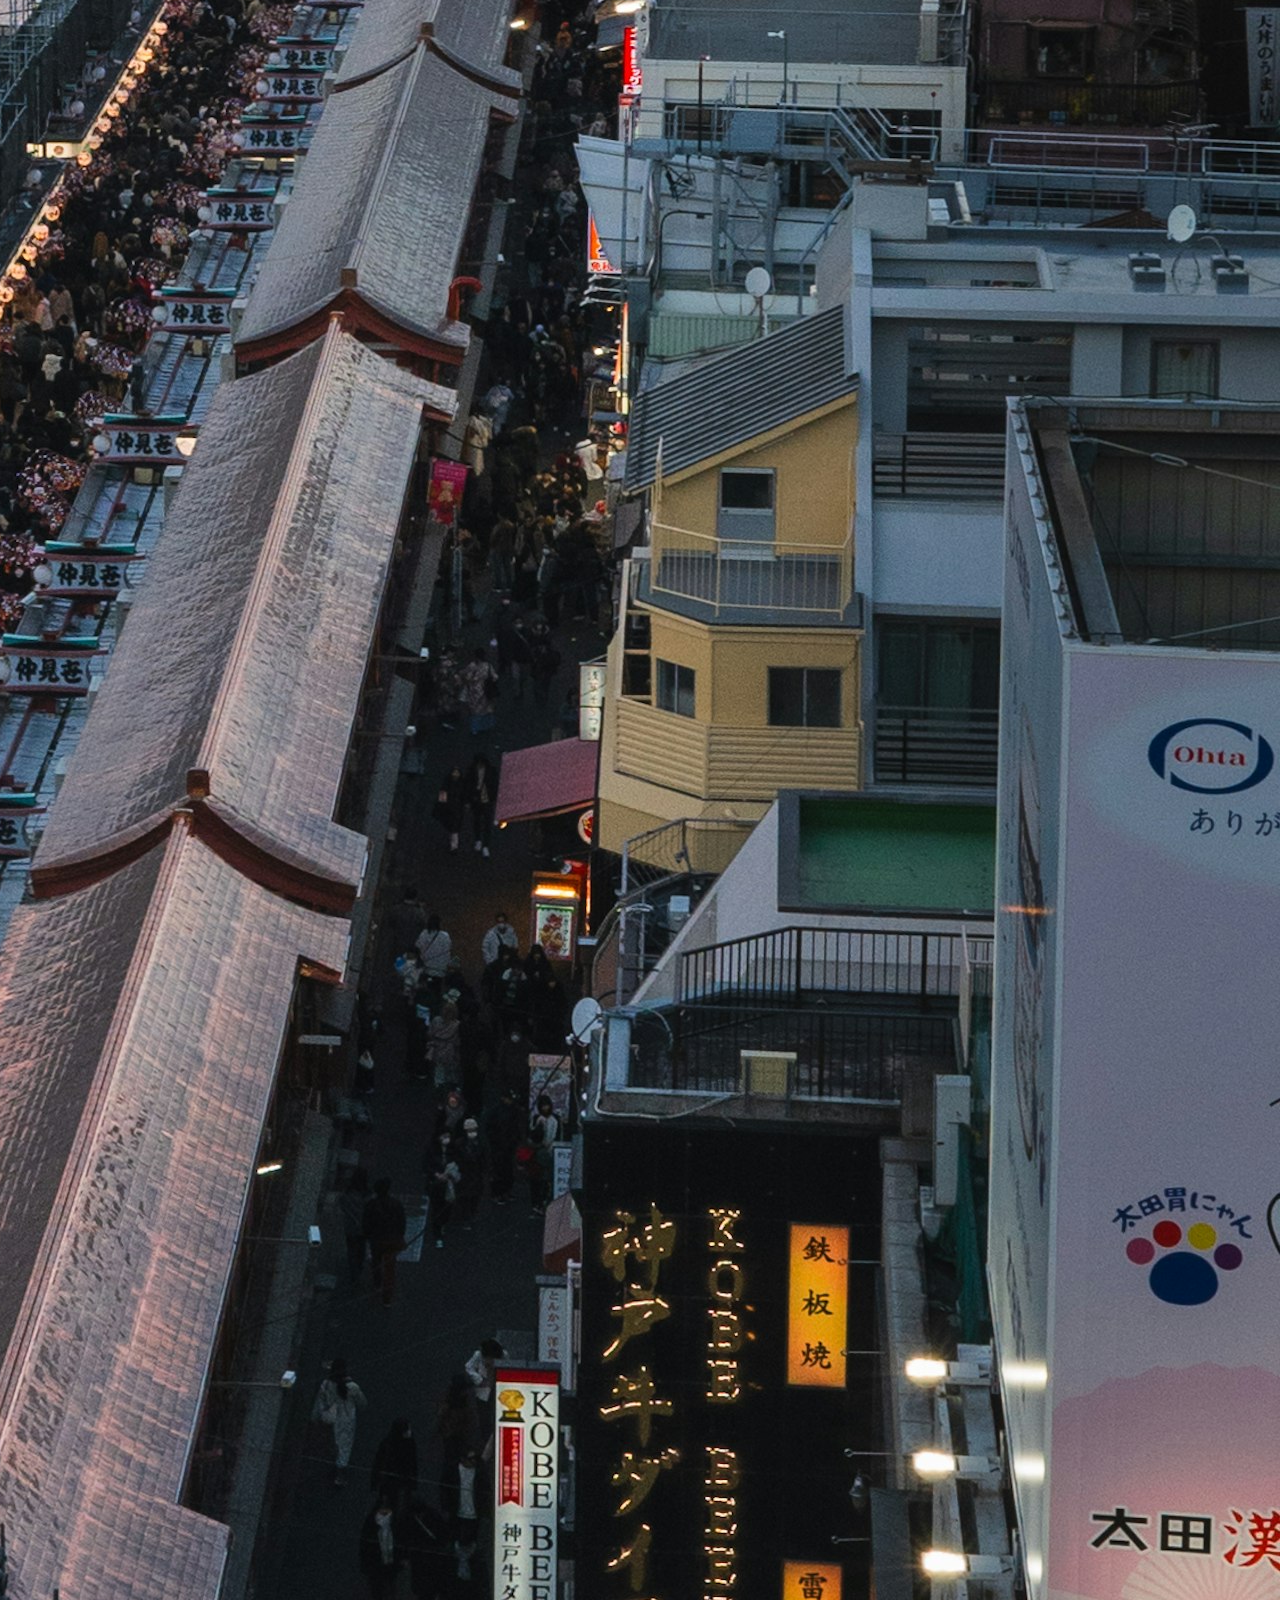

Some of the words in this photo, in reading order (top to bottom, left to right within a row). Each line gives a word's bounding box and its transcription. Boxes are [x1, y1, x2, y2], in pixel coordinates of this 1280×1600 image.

[1174, 746, 1245, 766] Ohta
[1112, 1187, 1253, 1238] 太田胃にゃん
[706, 1208, 745, 1403] KOBE
[801, 1236, 835, 1370] 鉄板焼
[530, 1390, 555, 1509] KOBE
